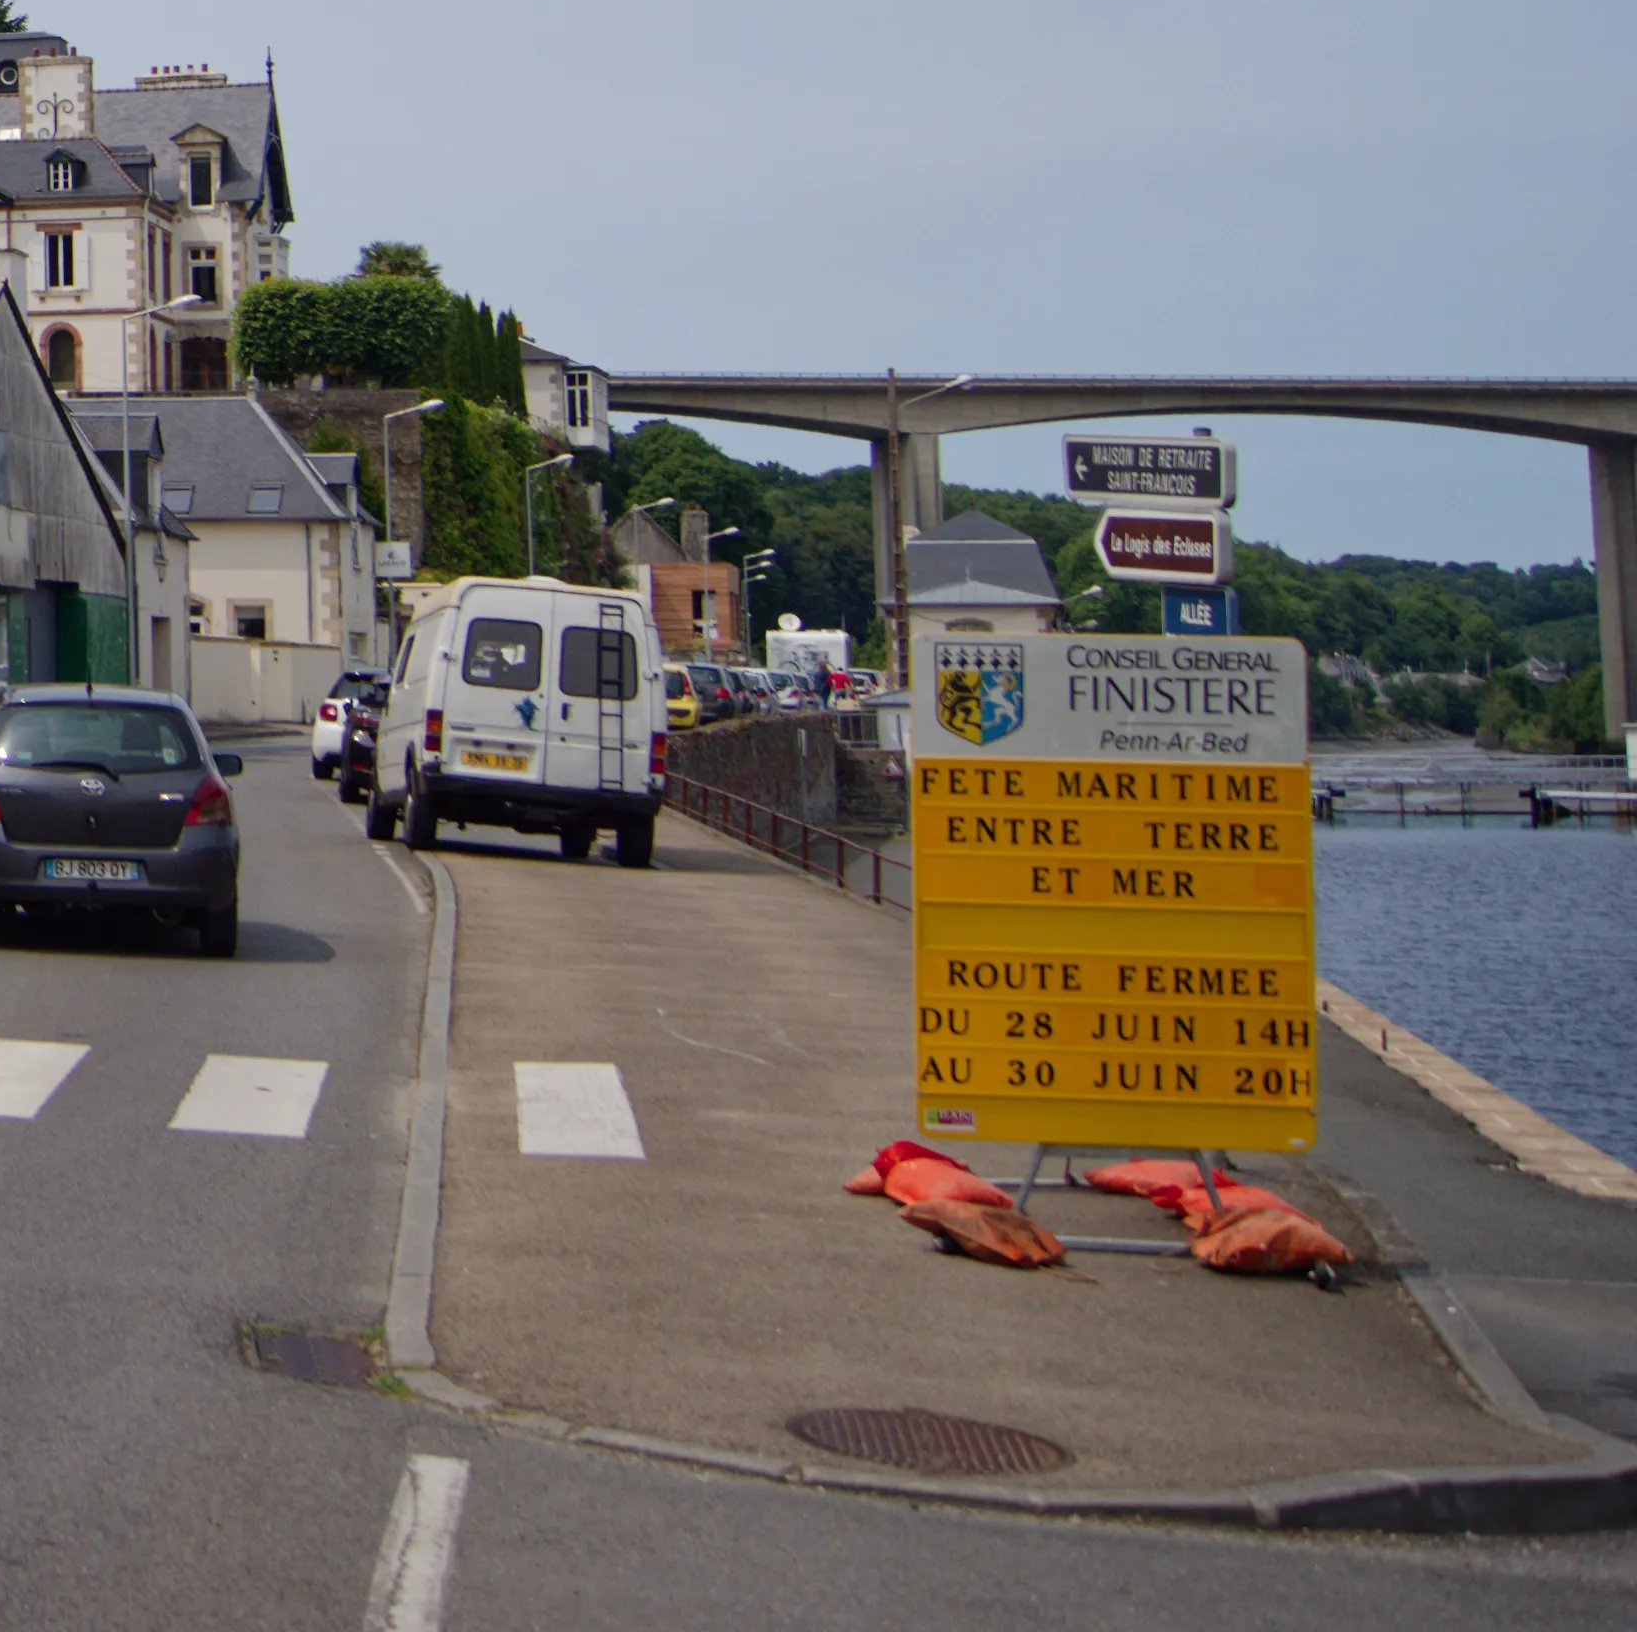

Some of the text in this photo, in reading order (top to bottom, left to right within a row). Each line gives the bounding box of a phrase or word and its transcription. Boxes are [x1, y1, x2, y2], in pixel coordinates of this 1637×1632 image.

[1092, 445, 1213, 471] MAISON DE RETRAITE
[1107, 471, 1197, 495] SAINT-FRANÇOIS
[1110, 532, 1212, 558] Le Logis des Ecluses
[1180, 599, 1213, 626] ALLÉE
[1067, 645, 1280, 672] CONSEIL GENERAL
[1068, 676, 1276, 715] FINISTERE
[1100, 730, 1248, 754] Penn-Ar-Bed
[920, 768, 1278, 802] FETE MARITIME
[947, 817, 1279, 851] ENTRE TERRE
[1031, 866, 1195, 897] ET MER
[948, 960, 1279, 997] ROUTE FERMEE
[919, 1007, 1309, 1047] DU 28 JUIN 14H
[920, 1057, 1310, 1096] AU 30 JUIN 20H
